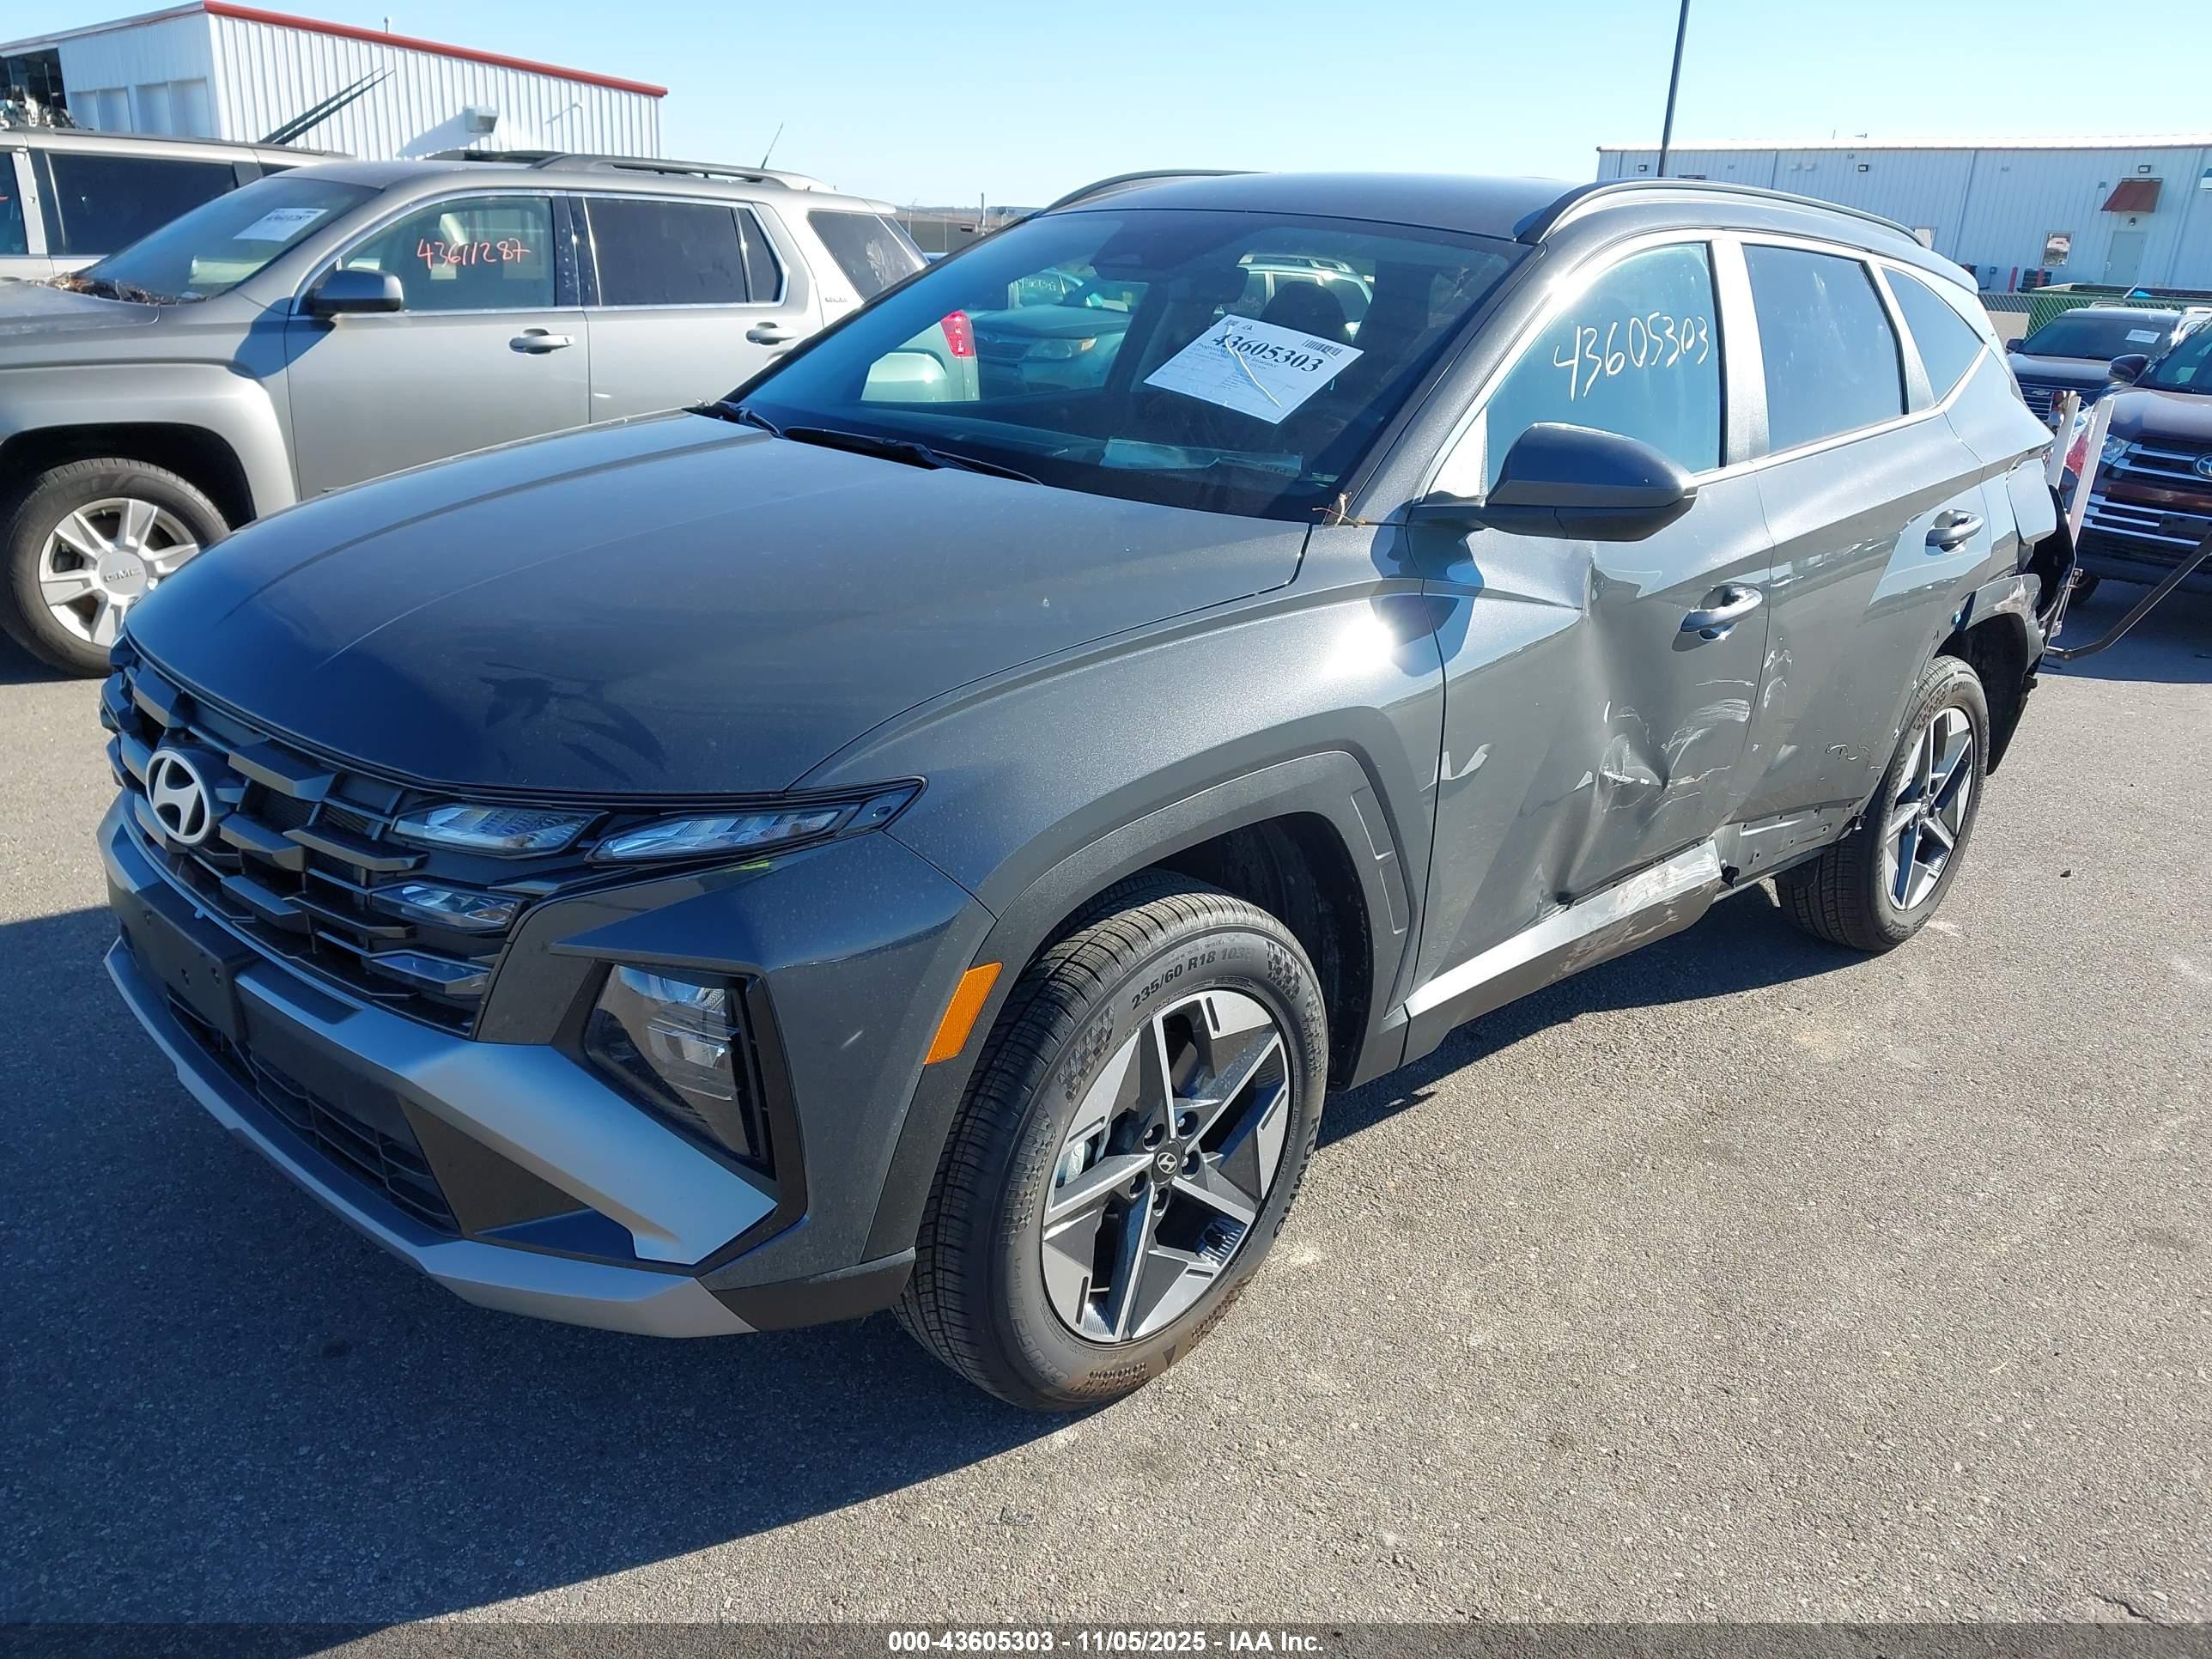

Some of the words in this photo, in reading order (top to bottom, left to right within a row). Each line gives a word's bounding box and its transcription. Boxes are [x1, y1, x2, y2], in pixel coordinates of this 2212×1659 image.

[416, 238, 532, 270] 43611287
[1212, 332, 1325, 373] 43605303
[1553, 311, 1710, 403] 43605303
[1131, 963, 1183, 1011] 235/60
[1187, 951, 1216, 972] R18
[1273, 1116, 1320, 1239] KUMHO
